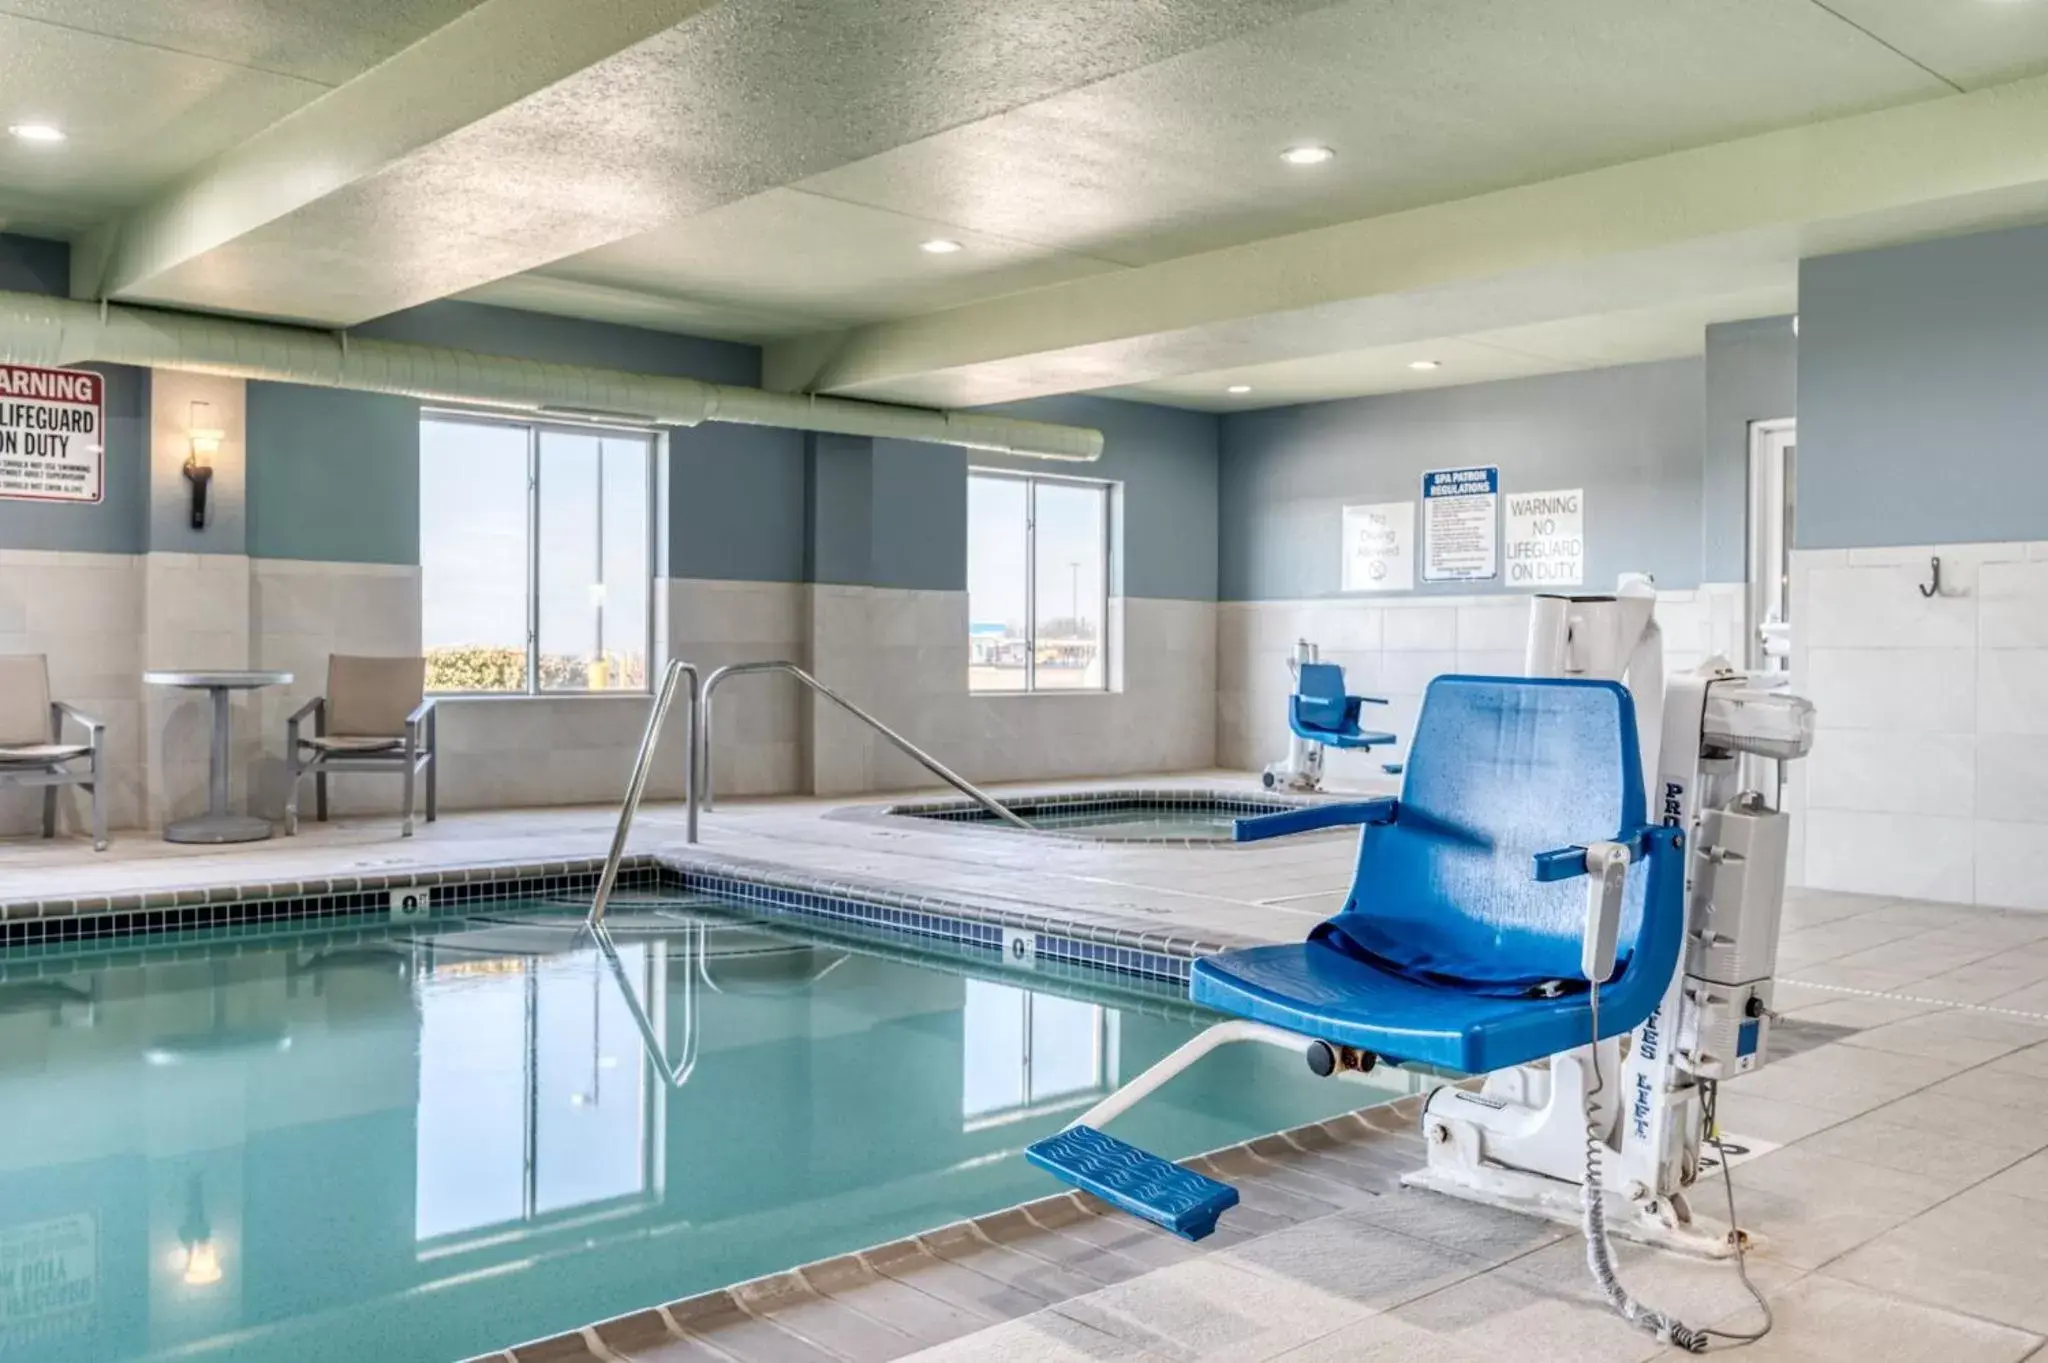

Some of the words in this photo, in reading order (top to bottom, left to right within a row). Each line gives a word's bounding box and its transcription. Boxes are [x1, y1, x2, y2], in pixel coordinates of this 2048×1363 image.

[0, 368, 93, 402] ARNING
[0, 403, 94, 433] LIFEGUARD
[25, 433, 70, 459] DUTY
[1434, 472, 1452, 485] SPA
[1452, 470, 1487, 482] PATRON
[1430, 481, 1490, 496] REGULATIONS
[1511, 495, 1578, 516] WARNING
[1532, 518, 1556, 535] NO
[1506, 538, 1580, 559] LIFEGUARD
[1511, 563, 1533, 580] ON
[1537, 561, 1576, 579] DUTY
